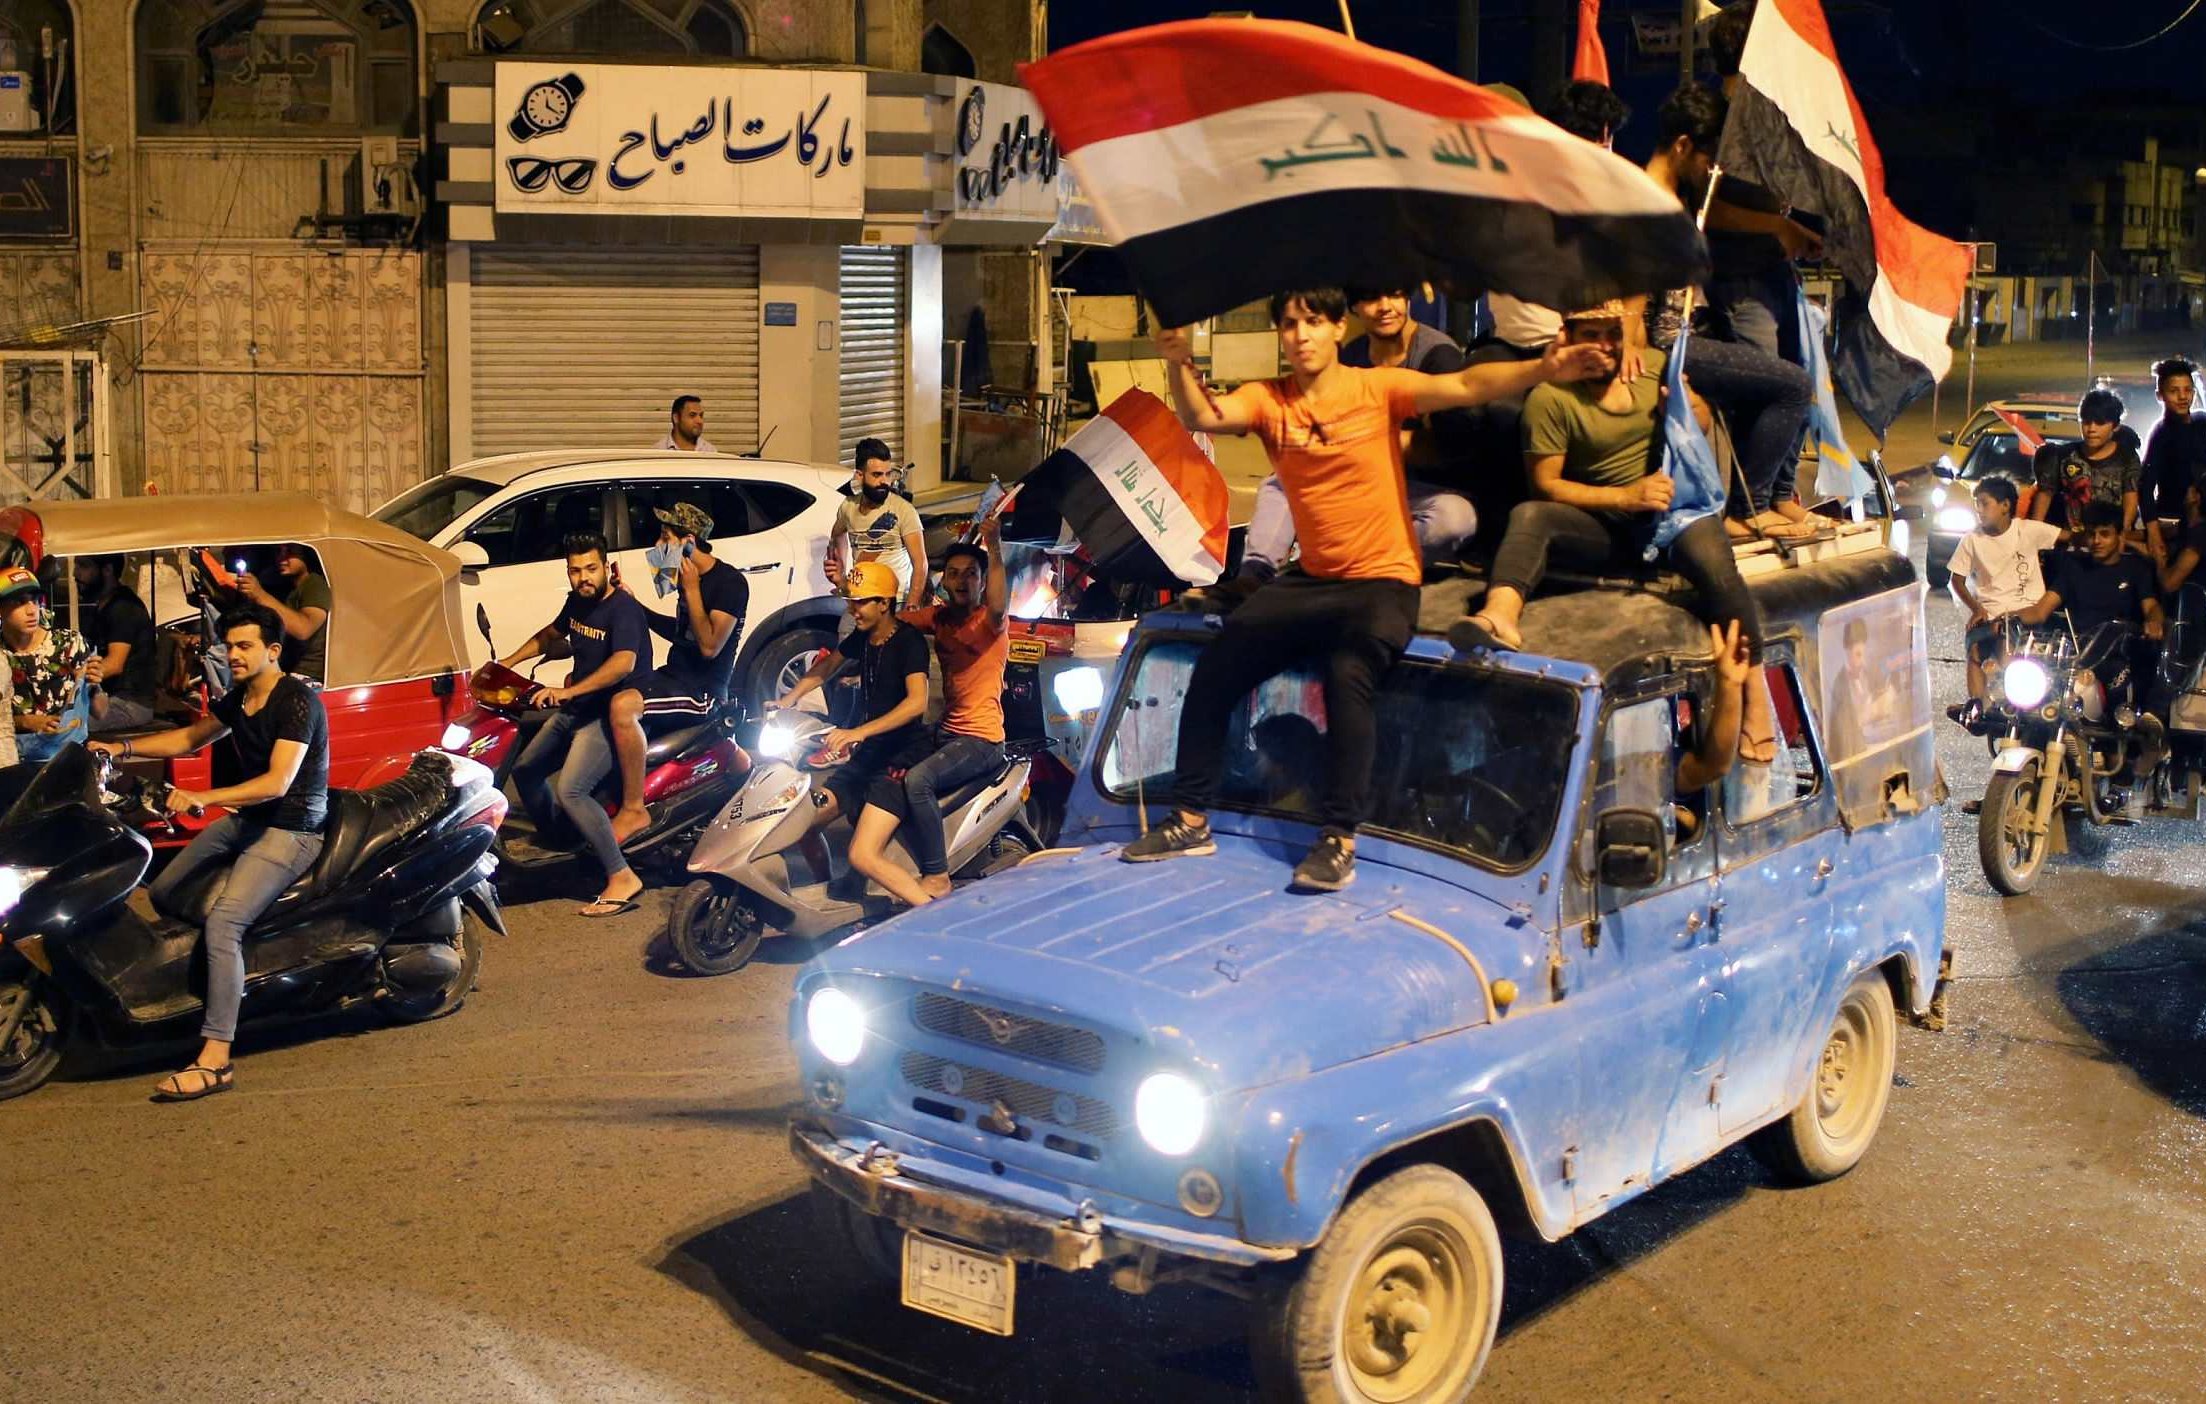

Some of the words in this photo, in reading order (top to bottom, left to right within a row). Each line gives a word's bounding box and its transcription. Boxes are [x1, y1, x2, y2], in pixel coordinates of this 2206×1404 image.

[606, 96, 735, 190] الصباح
[724, 93, 854, 178] ماركات
[1430, 121, 1510, 174] الله
